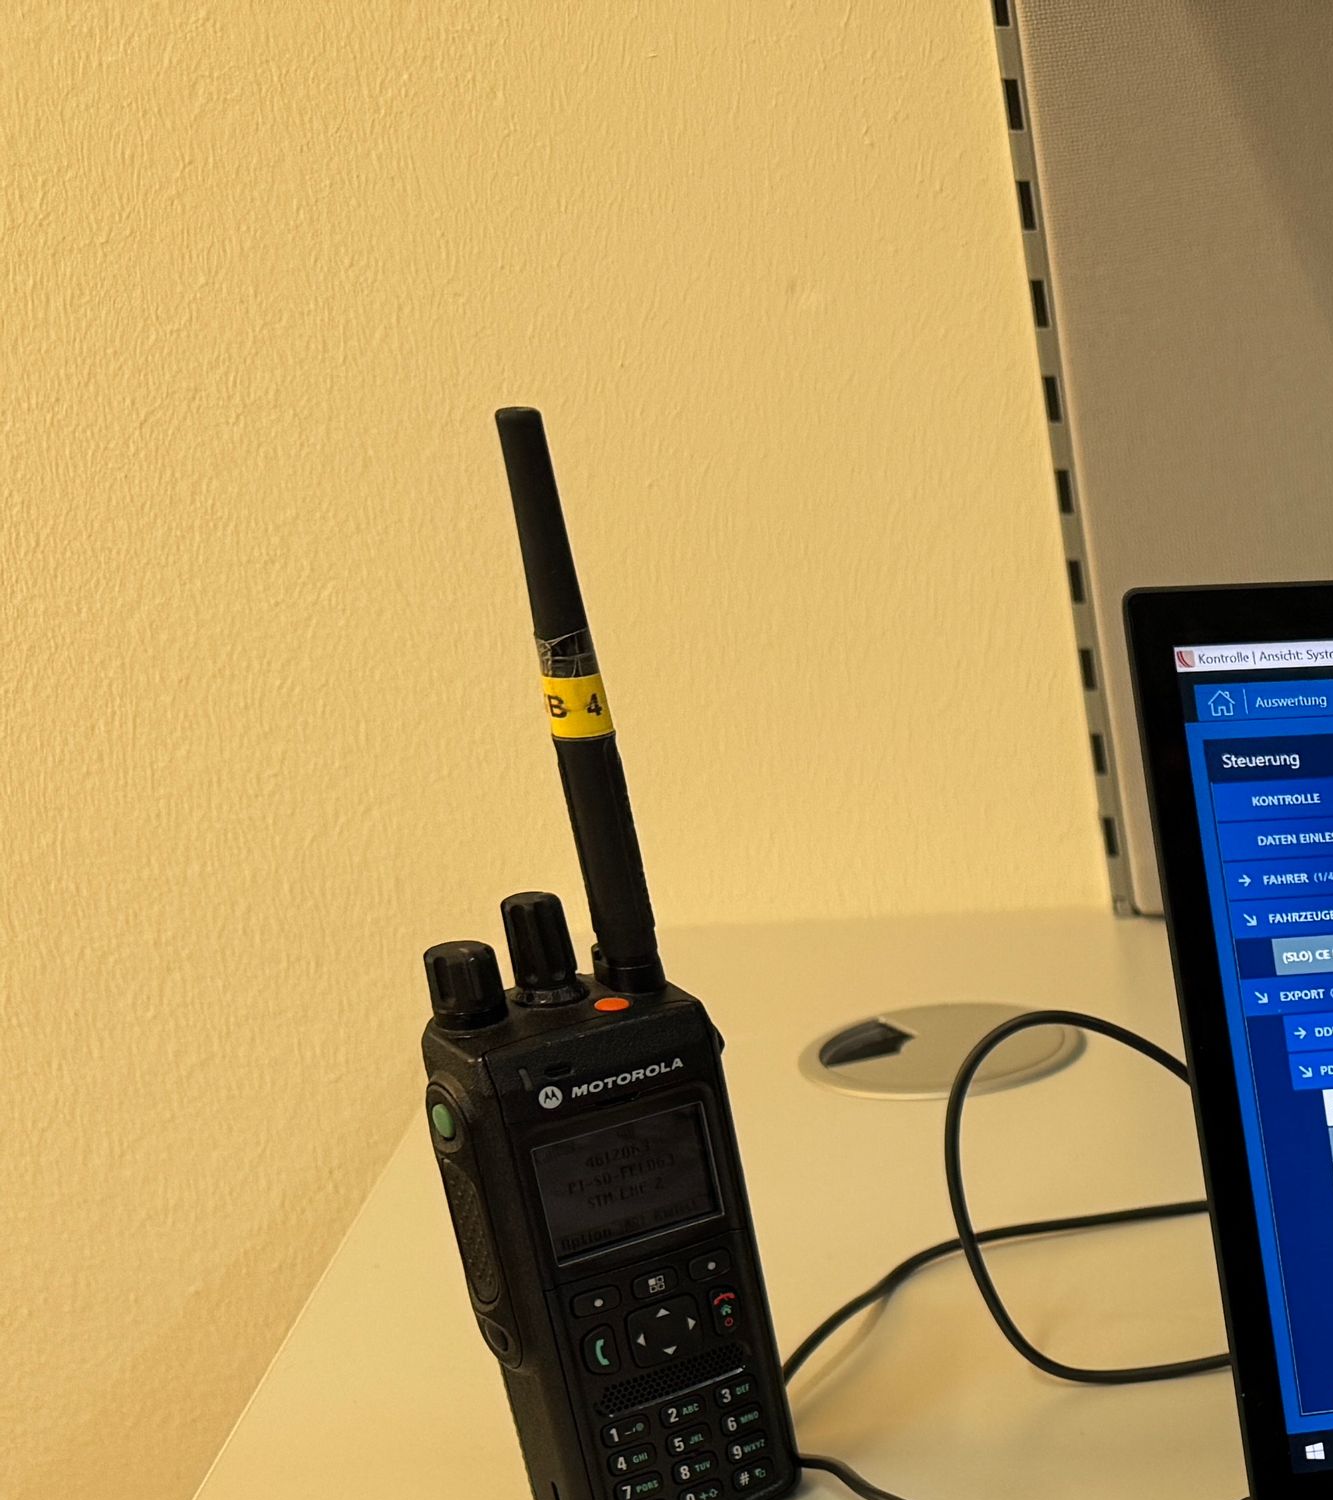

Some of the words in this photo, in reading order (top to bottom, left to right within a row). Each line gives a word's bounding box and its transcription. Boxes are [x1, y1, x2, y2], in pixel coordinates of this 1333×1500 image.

[1198, 651, 1249, 665] Kontrolle
[1259, 649, 1302, 662] Ansicht:
[587, 693, 602, 716] 4
[1256, 695, 1327, 708] Auswertung
[1222, 754, 1300, 769] Steuerung
[1252, 793, 1321, 807] KONTROLLE
[1258, 834, 1297, 846] DATEN
[1262, 873, 1309, 886] FAHRER
[1282, 951, 1313, 964] (SLO)
[1316, 949, 1329, 961] CE
[1280, 988, 1325, 1001] EXPORT
[571, 1058, 683, 1099] MOTOROLA
[722, 1388, 732, 1402] 3
[668, 1408, 678, 1421] 2
[727, 1418, 736, 1431] 6
[609, 1428, 618, 1442] 1
[674, 1438, 684, 1451] 5
[733, 1445, 743, 1459] 9
[617, 1457, 626, 1470] 4
[680, 1466, 690, 1479] 8
[622, 1486, 632, 1499] 7
